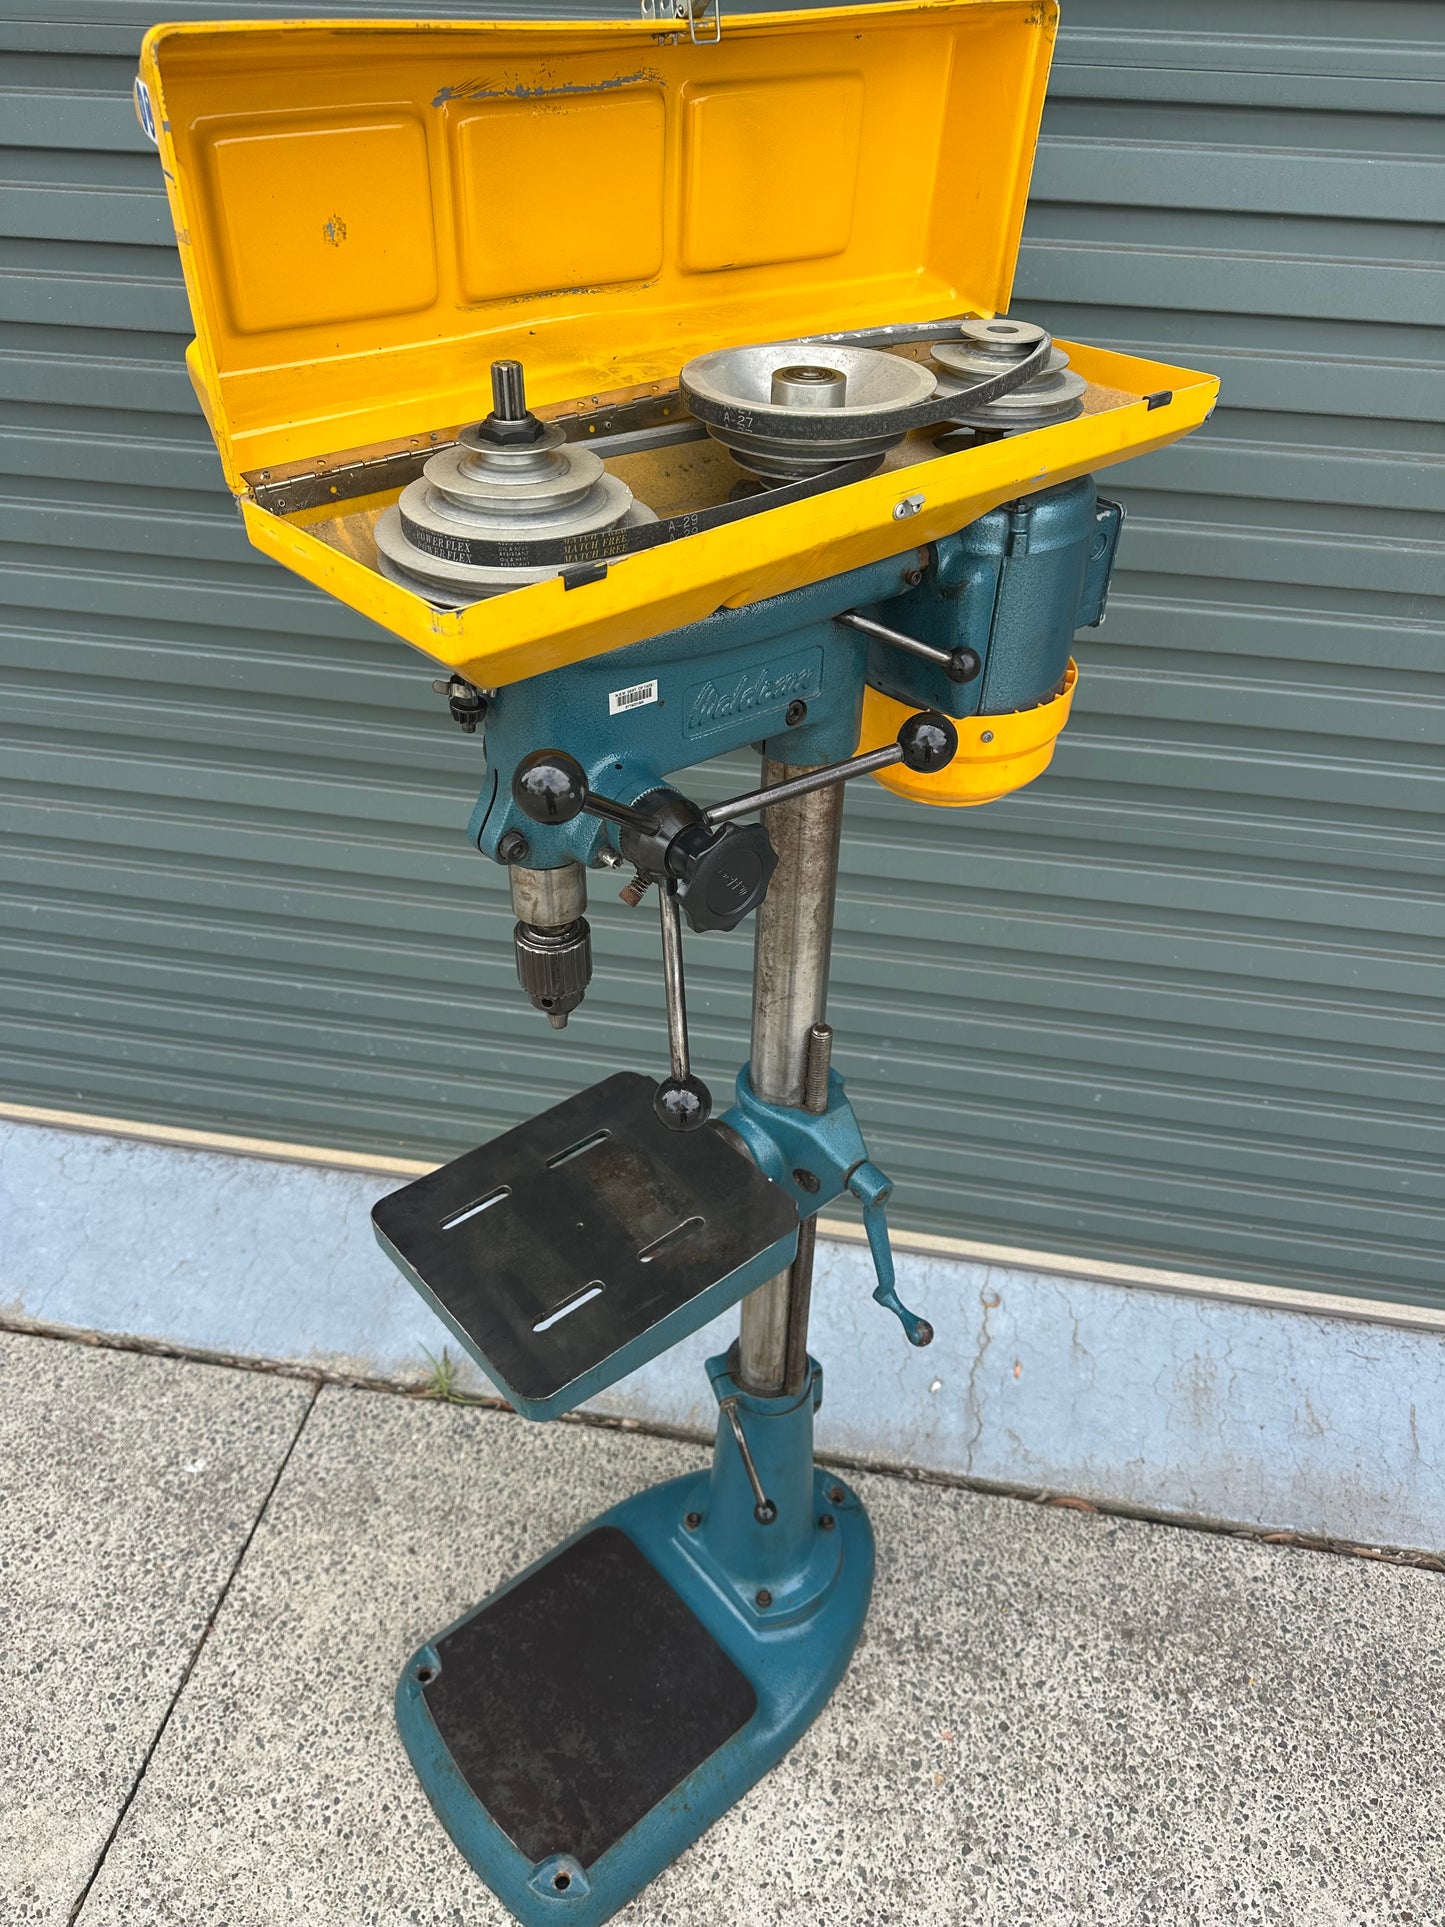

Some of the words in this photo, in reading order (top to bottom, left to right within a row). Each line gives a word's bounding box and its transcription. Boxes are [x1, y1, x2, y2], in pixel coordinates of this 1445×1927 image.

[723, 411, 753, 428] A-27
[668, 513, 698, 531] A-29
[564, 541, 598, 554] MATCH
[603, 534, 628, 547] FREE
[565, 550, 599, 563] MATCH
[603, 544, 629, 557] FREE
